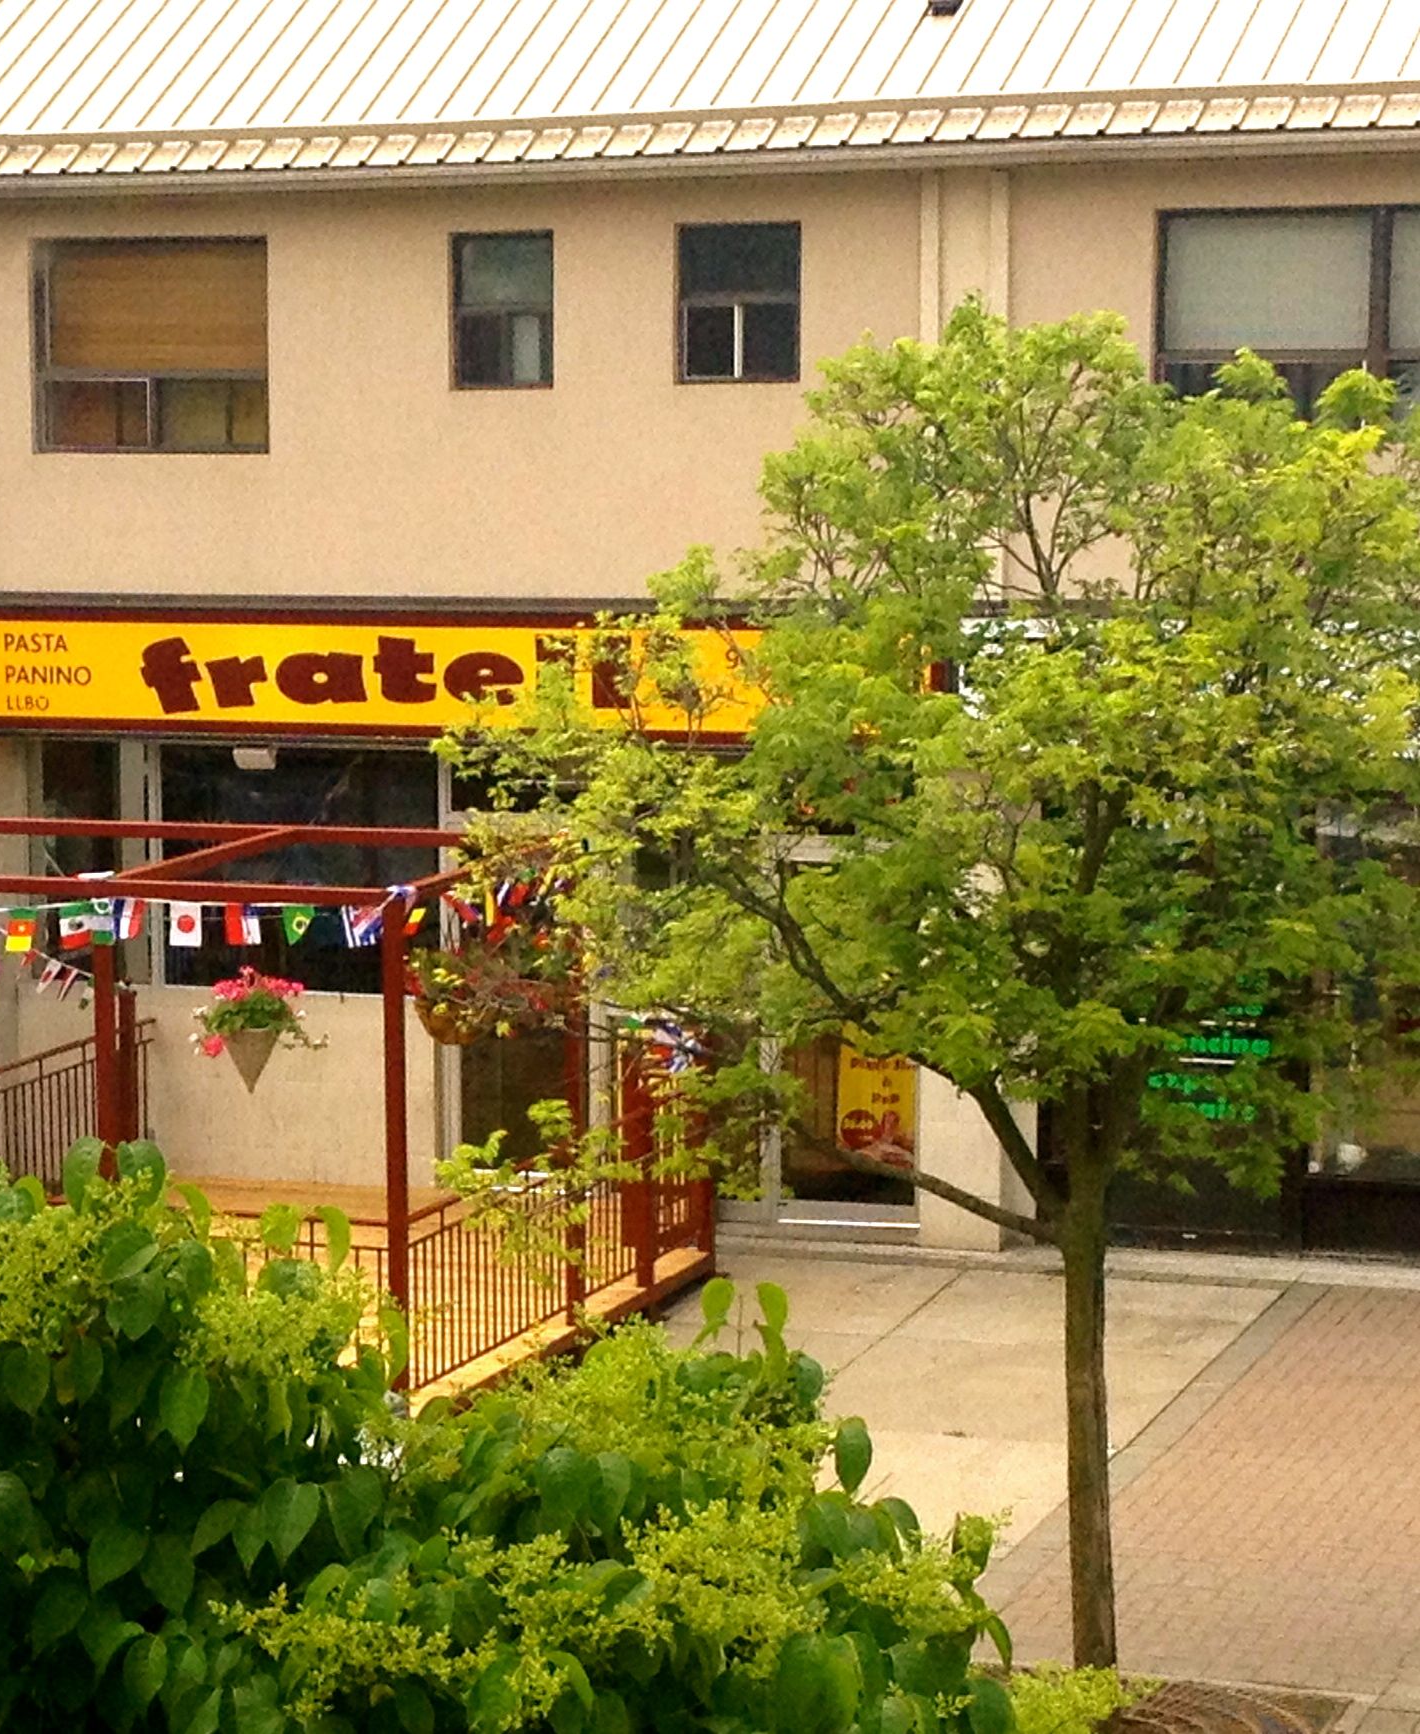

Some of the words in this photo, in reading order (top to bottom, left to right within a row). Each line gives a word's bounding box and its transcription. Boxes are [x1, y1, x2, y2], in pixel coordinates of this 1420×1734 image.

[4, 633, 69, 654] PASTA
[5, 664, 92, 687] PANINO
[6, 695, 50, 712] LLBO
